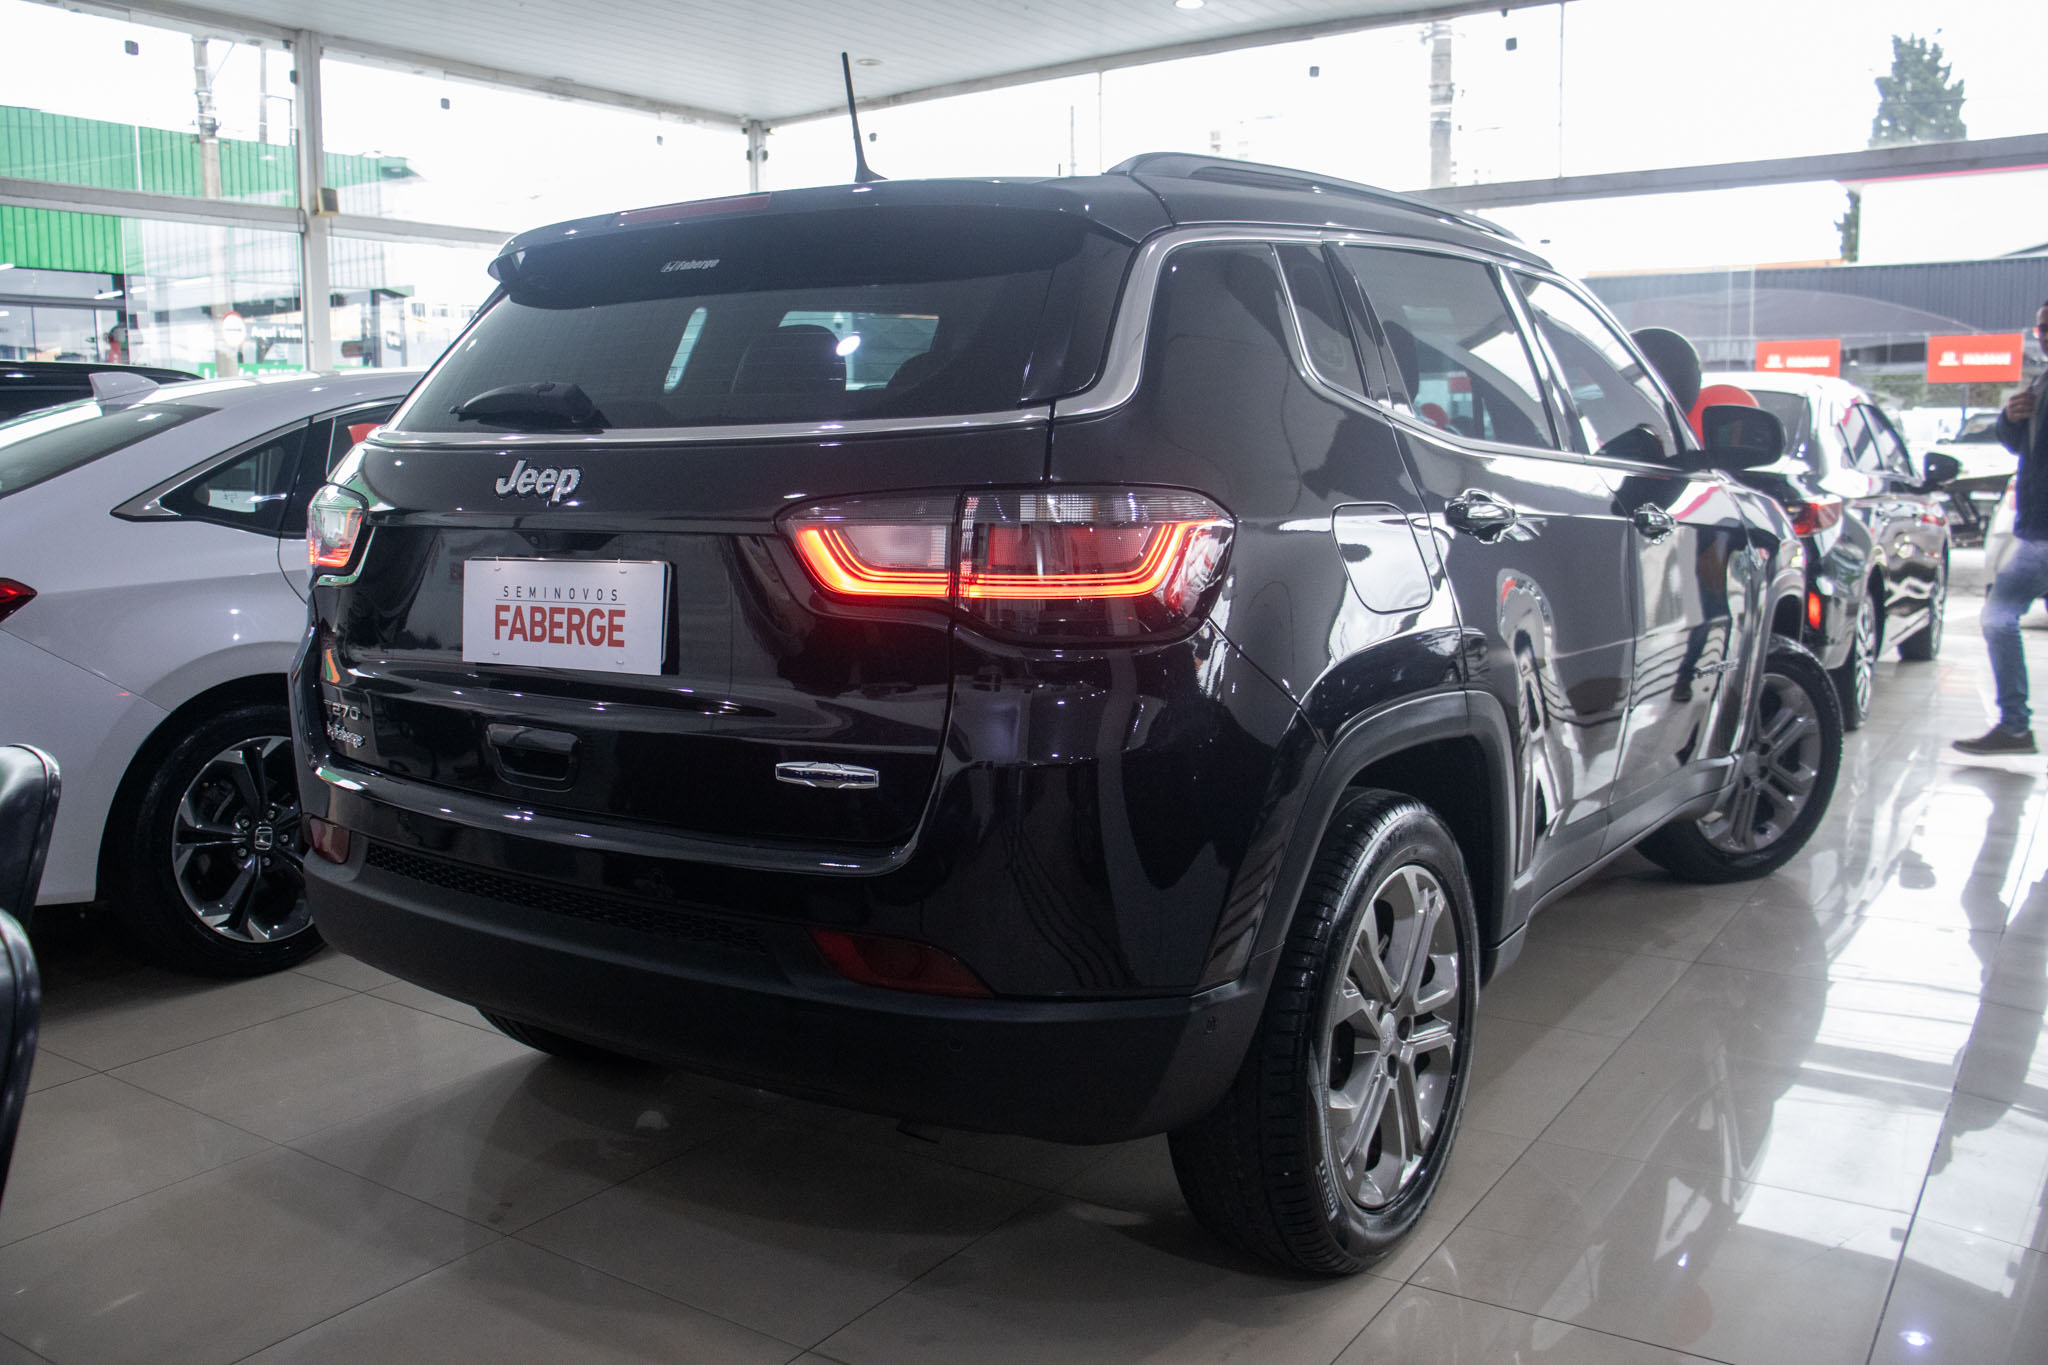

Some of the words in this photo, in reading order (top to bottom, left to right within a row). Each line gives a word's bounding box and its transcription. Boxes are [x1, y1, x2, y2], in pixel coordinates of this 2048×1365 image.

[495, 459, 581, 502] Jeep
[503, 585, 618, 602] SEMINOVOS
[494, 604, 626, 648] FABERGE
